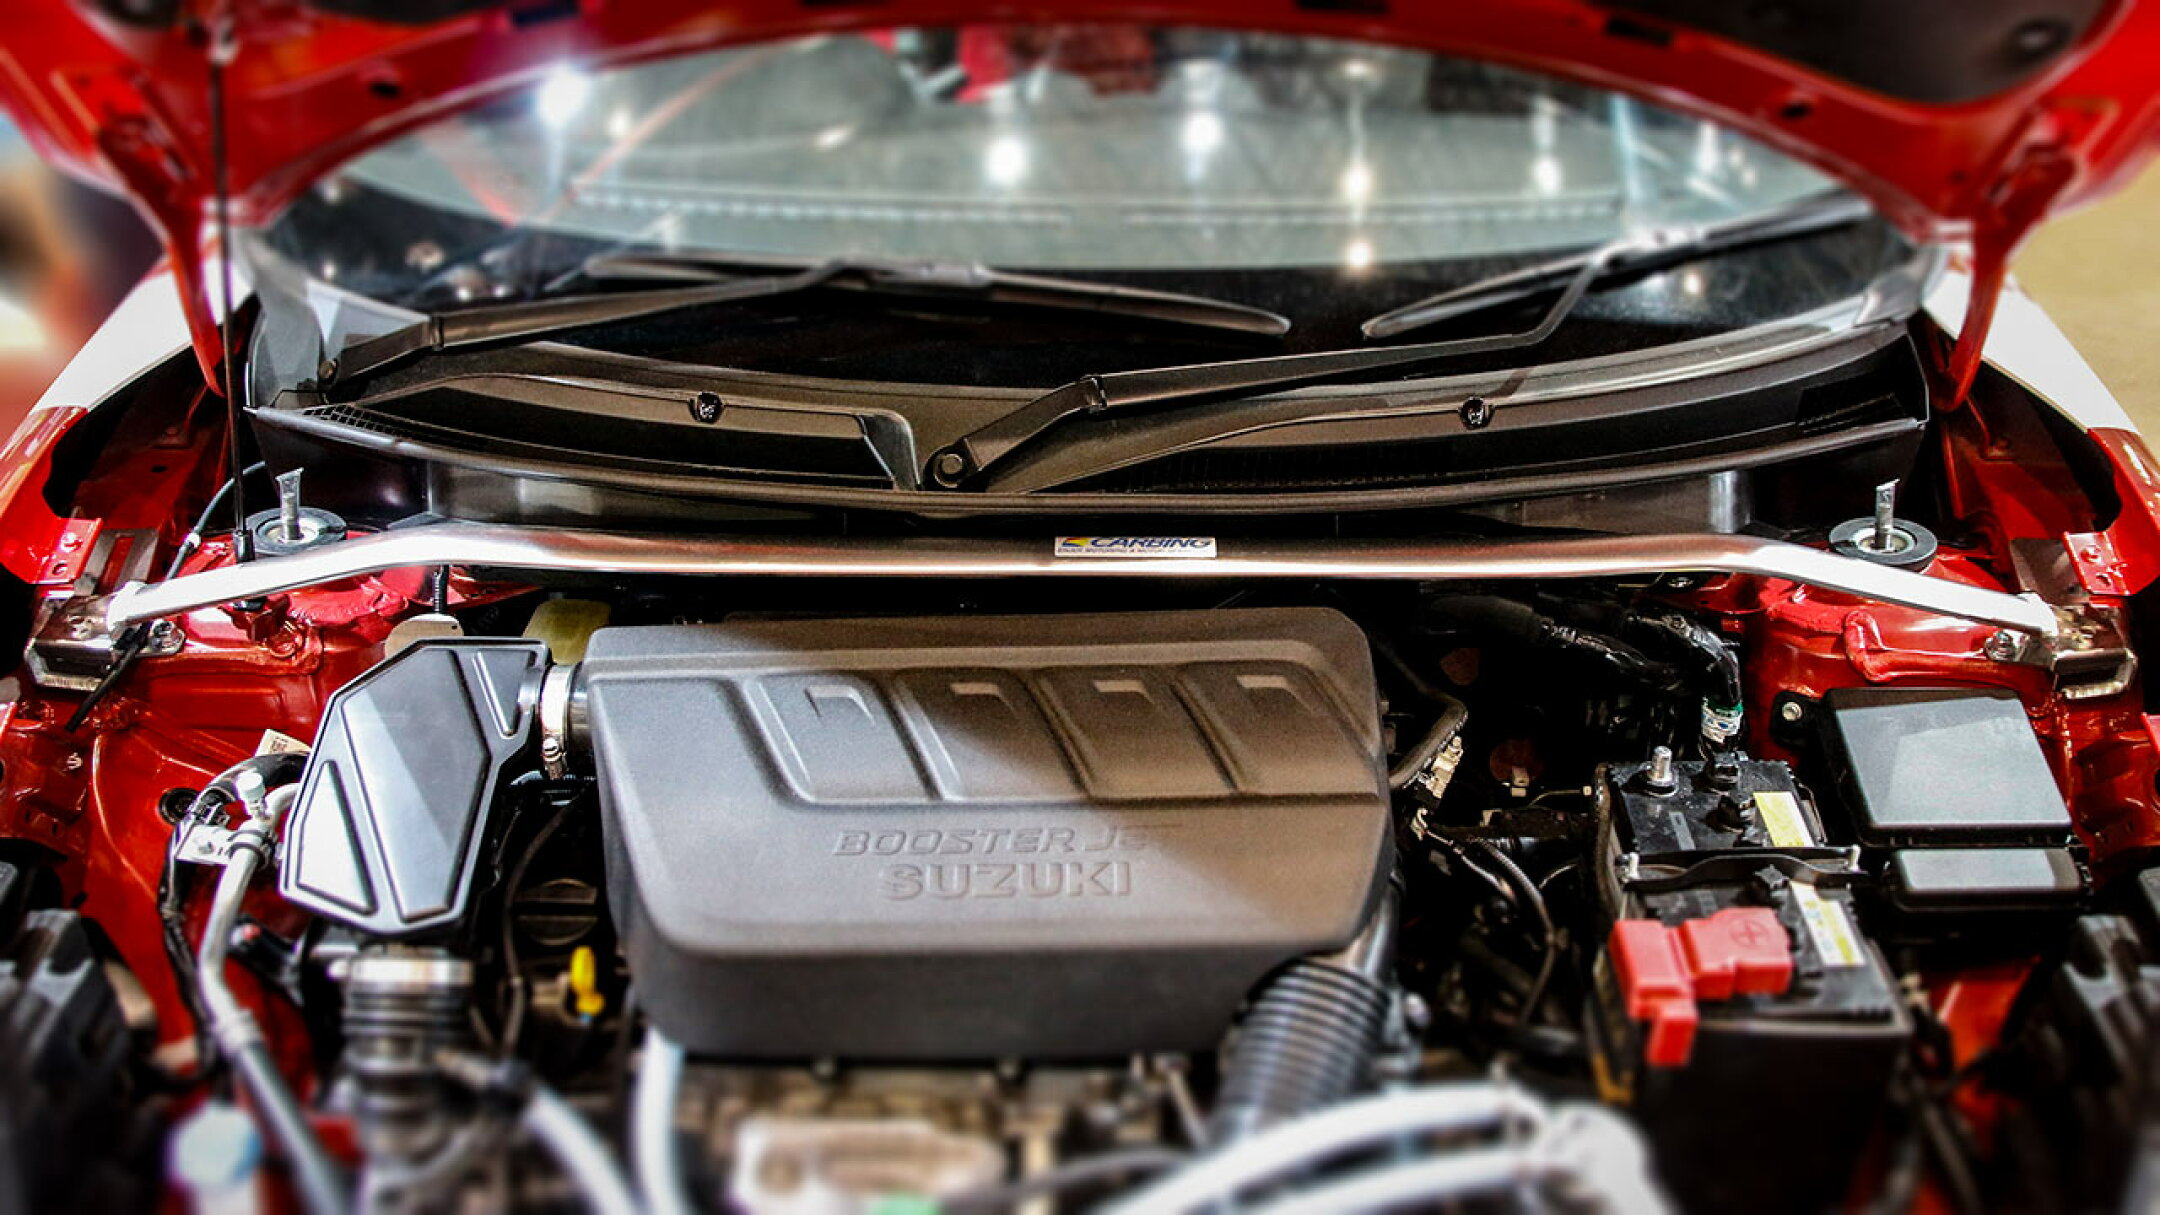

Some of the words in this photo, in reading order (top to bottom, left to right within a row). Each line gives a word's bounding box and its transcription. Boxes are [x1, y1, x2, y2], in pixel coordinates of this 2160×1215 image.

[1090, 537, 1211, 548] CARBING
[833, 826, 1076, 857] BOOSTER
[880, 861, 1131, 900] SUZUKI
